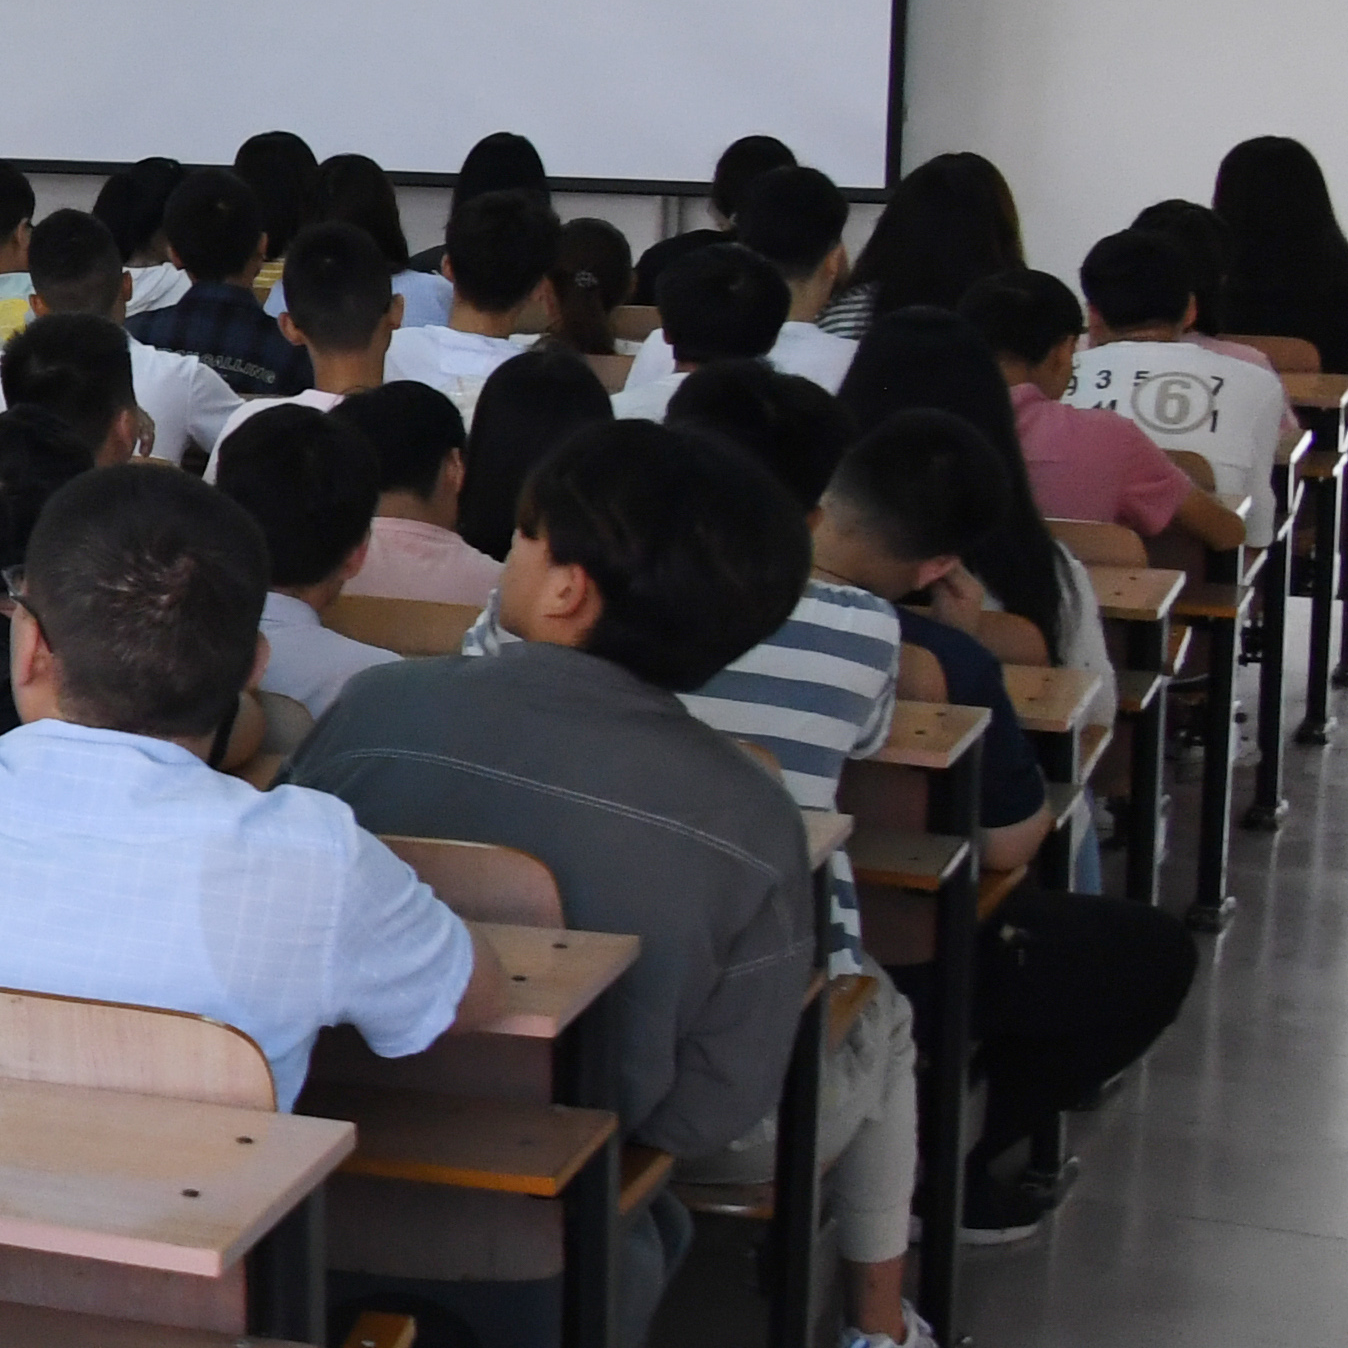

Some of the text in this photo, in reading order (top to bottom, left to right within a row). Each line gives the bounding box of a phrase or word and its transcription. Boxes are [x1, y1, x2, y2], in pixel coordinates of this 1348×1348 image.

[1095, 369, 1112, 390] 3
[1210, 375, 1224, 396] 7
[1154, 379, 1191, 425] 6
